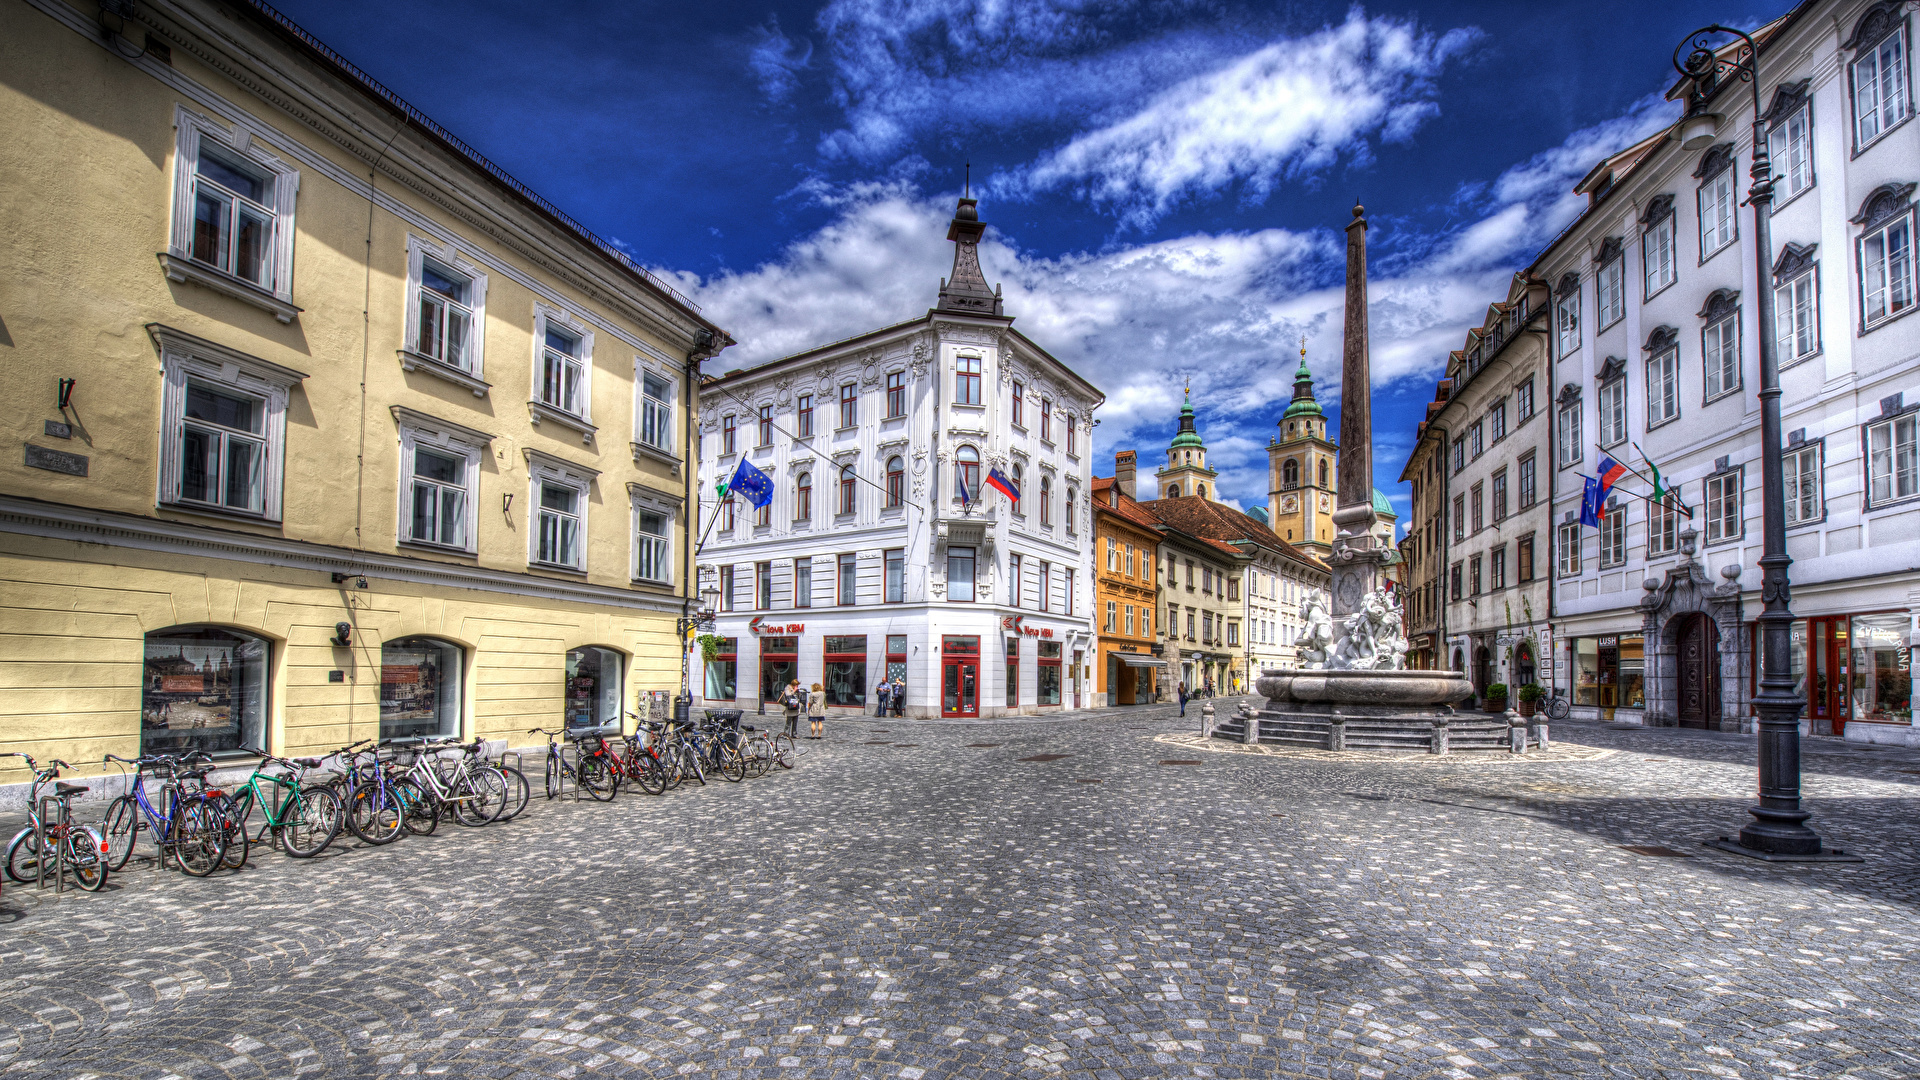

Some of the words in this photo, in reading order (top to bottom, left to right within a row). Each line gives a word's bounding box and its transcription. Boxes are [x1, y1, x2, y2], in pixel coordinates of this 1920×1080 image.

[786, 623, 805, 633] KBM
[1023, 625, 1040, 637] Nova
[1040, 627, 1054, 638] KBM
[1599, 636, 1617, 645] LUSH
